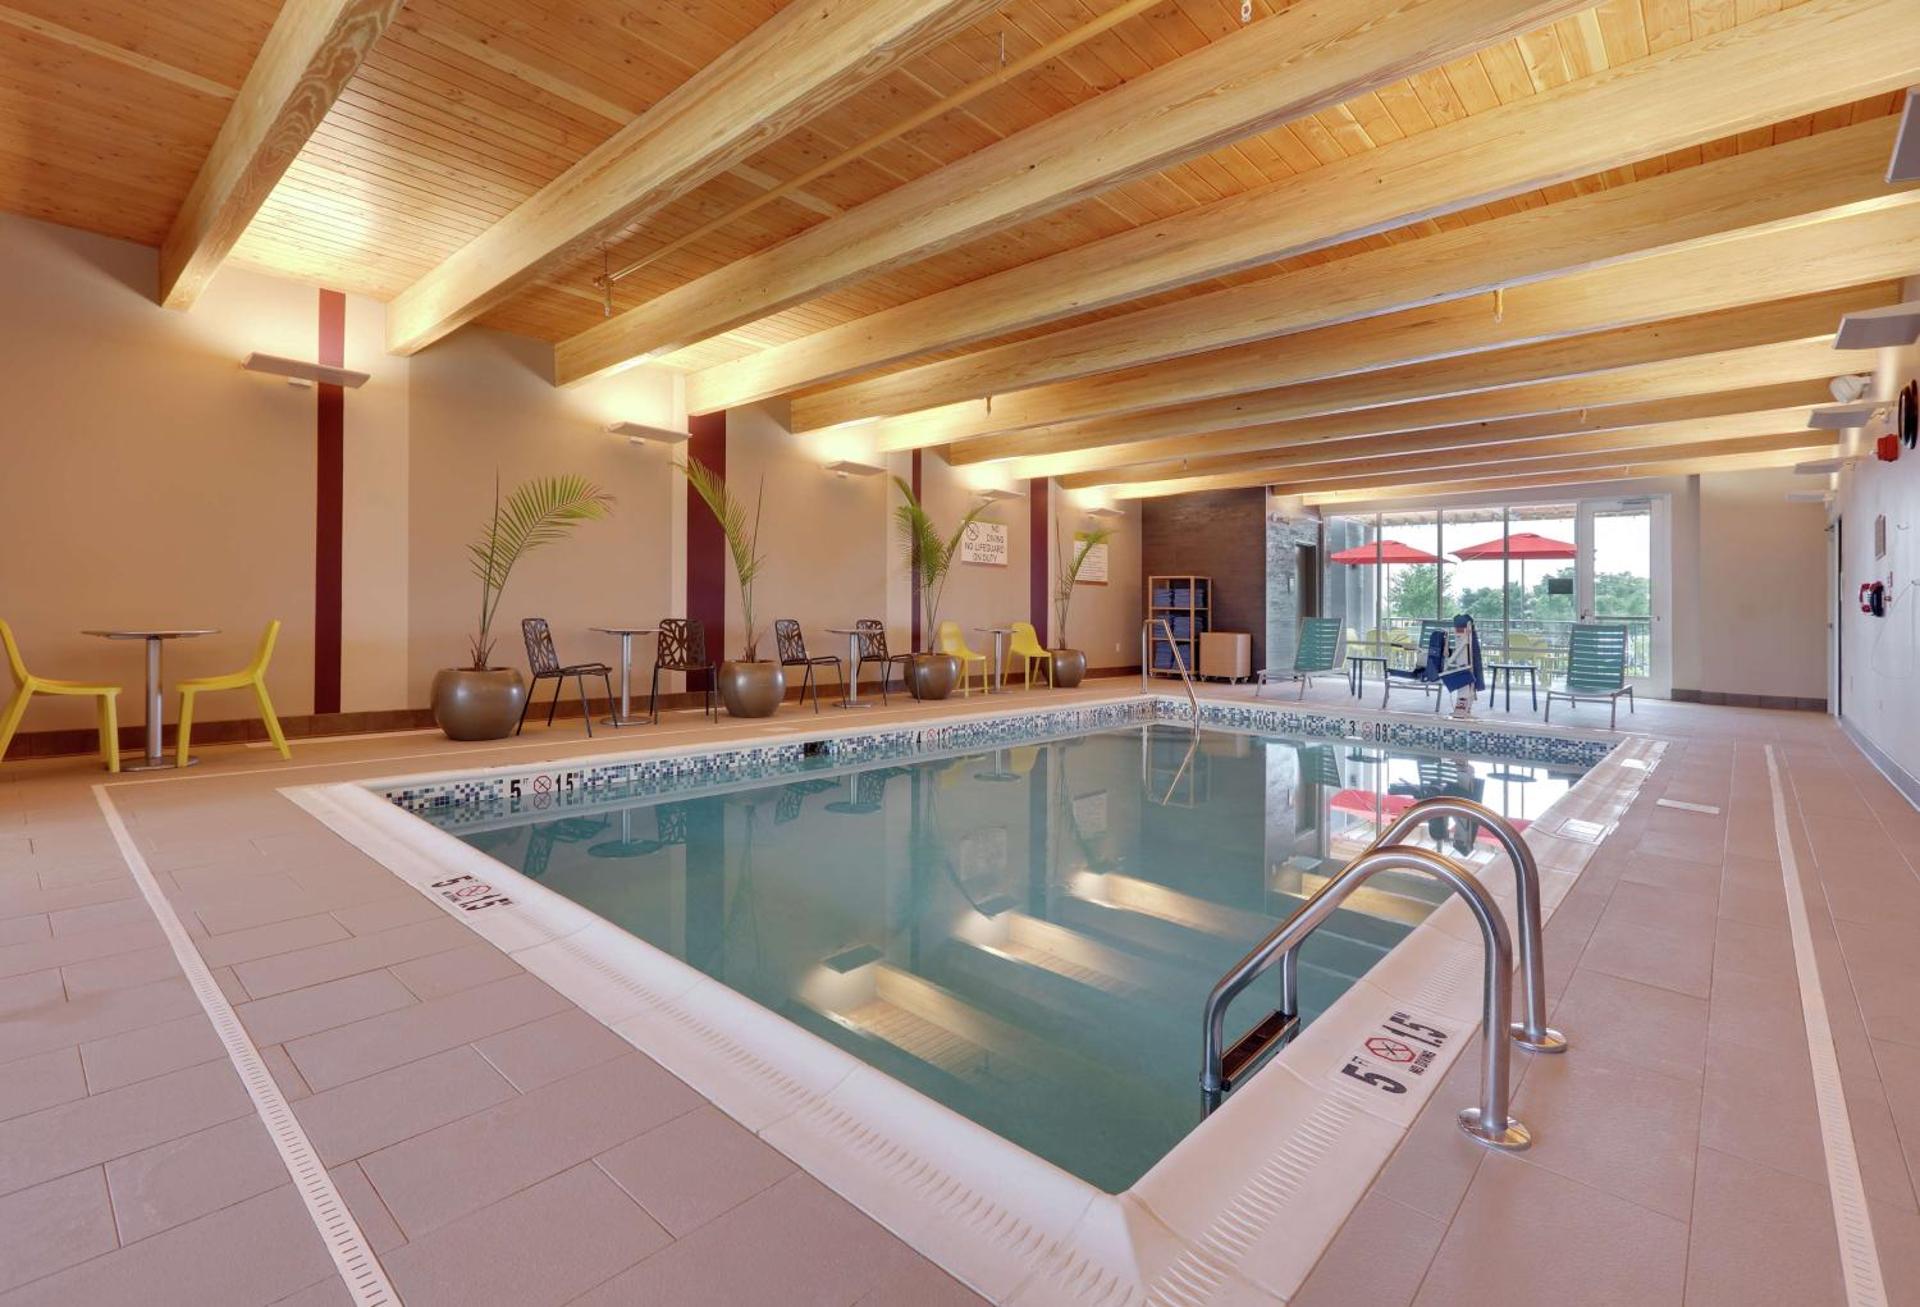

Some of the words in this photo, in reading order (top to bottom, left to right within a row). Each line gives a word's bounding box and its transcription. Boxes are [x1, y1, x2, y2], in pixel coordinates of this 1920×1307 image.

[986, 534, 1005, 544] DIVING
[964, 542, 974, 550] NO
[975, 543, 1005, 554] LIFEGUARD
[972, 552, 982, 561] ON
[982, 553, 998, 562] DUTY
[510, 779, 522, 798] 5
[431, 874, 473, 888] 5
[1341, 1063, 1408, 1094] 5
